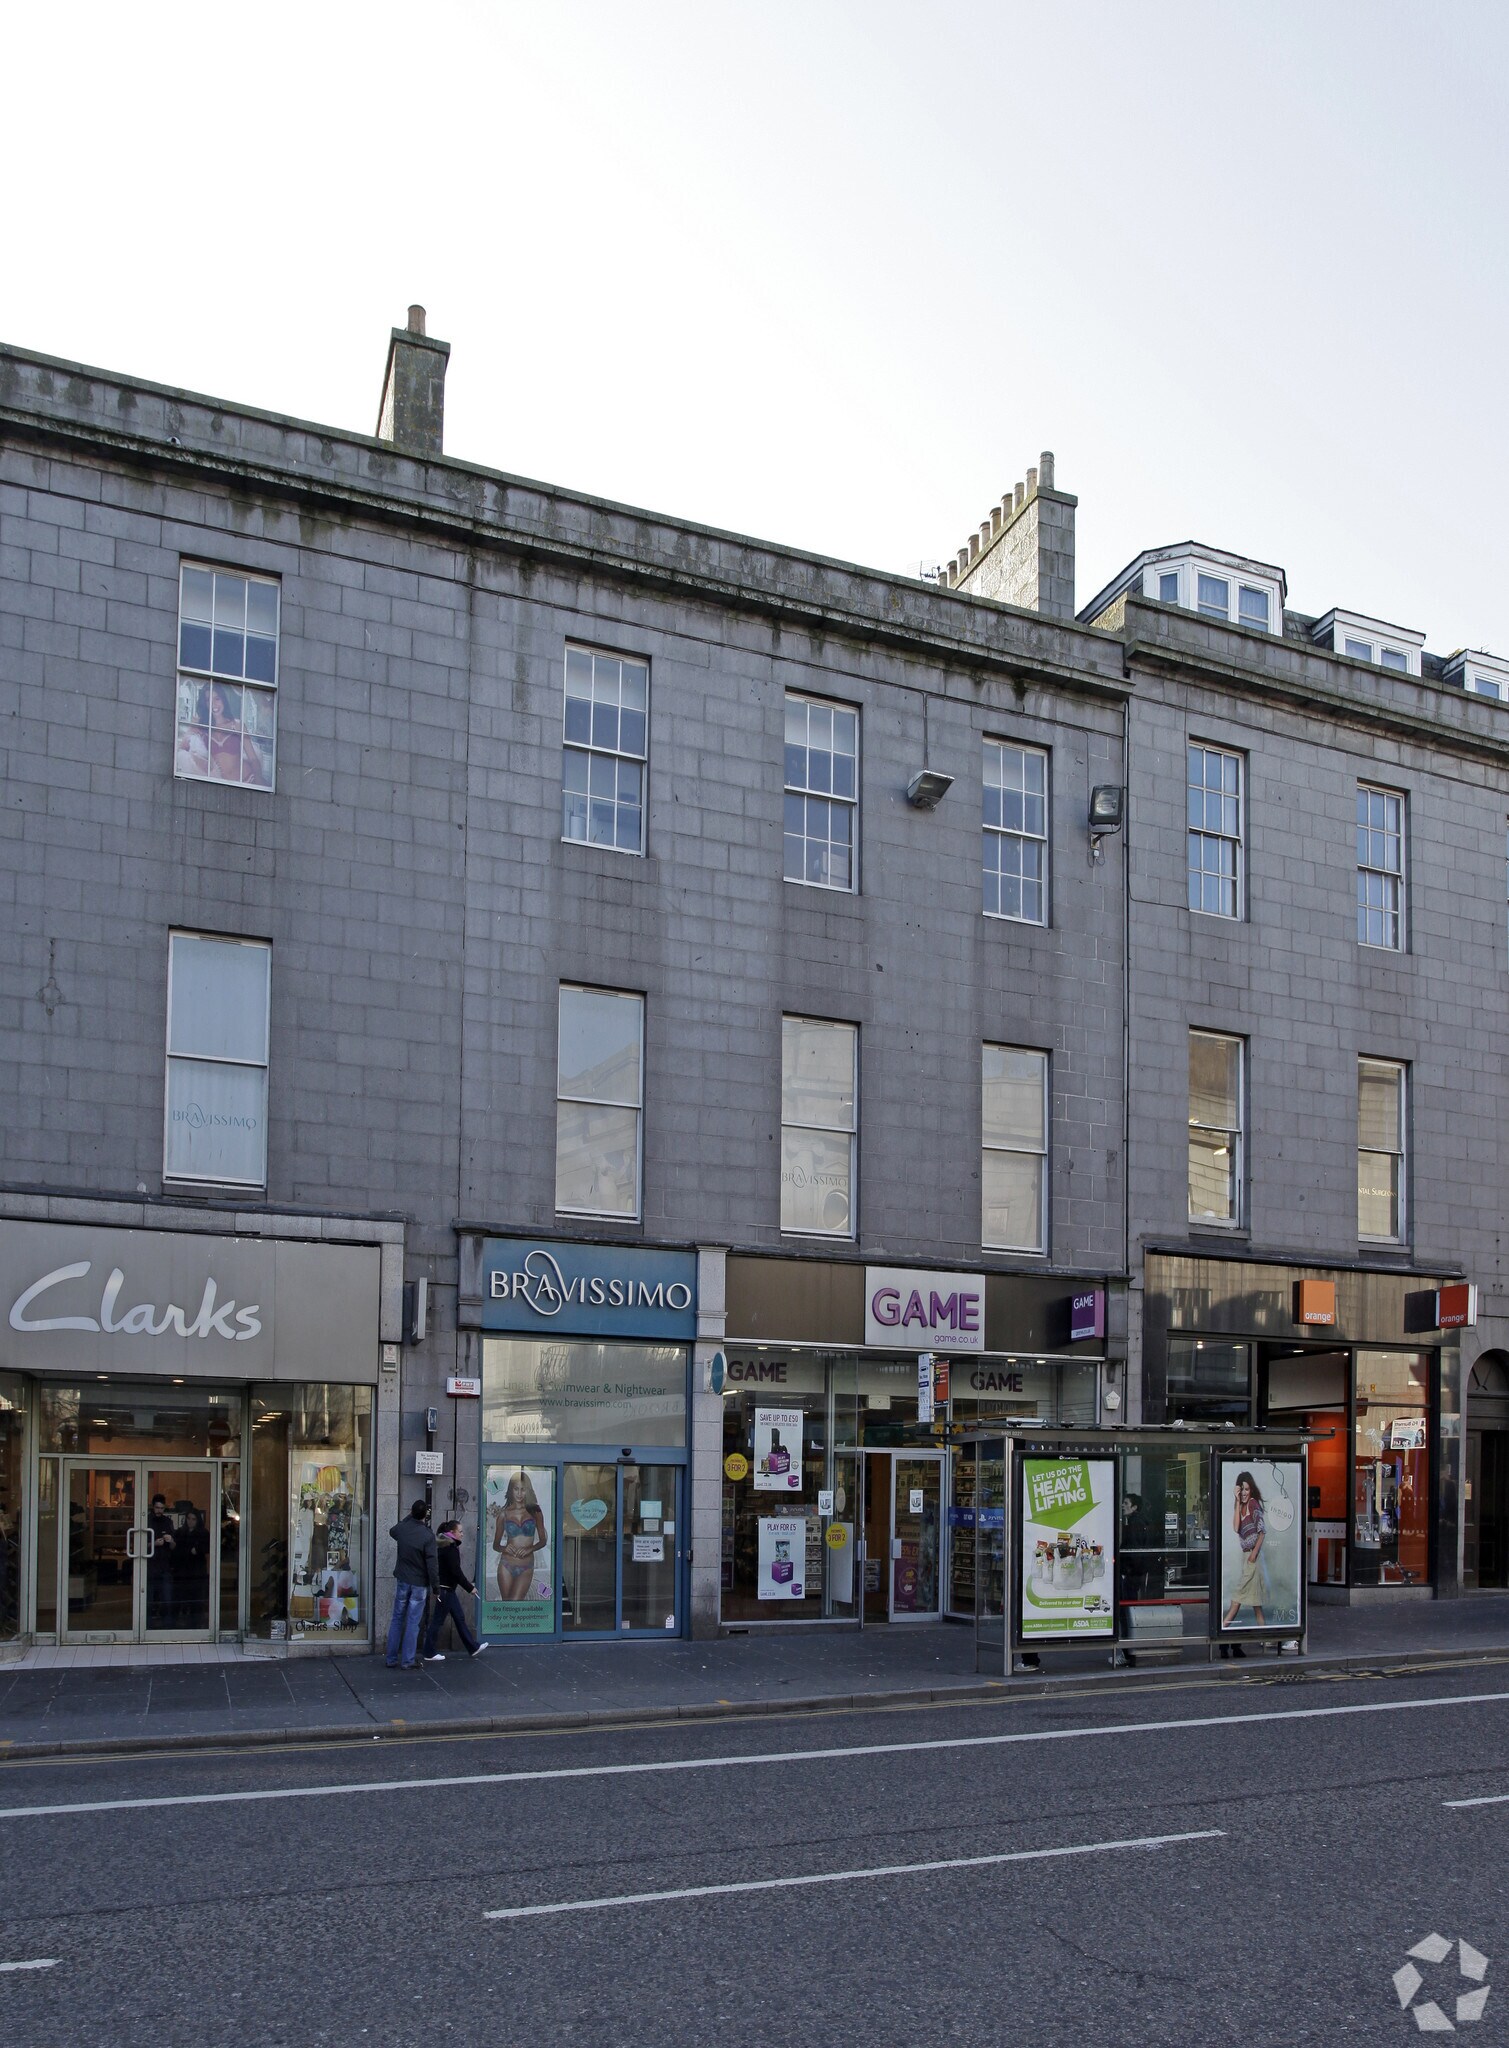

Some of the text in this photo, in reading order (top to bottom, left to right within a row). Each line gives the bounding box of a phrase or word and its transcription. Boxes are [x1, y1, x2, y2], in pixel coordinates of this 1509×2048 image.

[172, 1102, 257, 1130] BRAVISSIMO
[781, 1165, 847, 1188] BRAVISSIMO
[490, 1250, 692, 1316] BRAVISSIMO
[9, 1260, 262, 1341] Clarks
[1073, 1295, 1093, 1310] GAME
[871, 1287, 980, 1331] GAME
[1304, 1312, 1331, 1322] orange
[1440, 1314, 1464, 1324] orange
[934, 1334, 979, 1345] game.co.uk
[727, 1360, 787, 1383] GAME
[548, 1380, 600, 1393] Swimwear
[603, 1383, 612, 1394] &
[616, 1383, 667, 1397] Nightwear
[970, 1371, 1023, 1393] GAME
[539, 1397, 632, 1409] www.bravissimo.com
[760, 1413, 798, 1423] SAVE UP TO £50
[731, 1463, 742, 1472] FOR
[742, 1464, 746, 1472] 2
[1032, 1465, 1082, 1482] LET US DO THE
[1033, 1472, 1082, 1498] HEAVY
[1035, 1488, 1087, 1512] LIFTING
[1270, 1505, 1292, 1519] INDIGO
[767, 1523, 779, 1531] PLAY
[780, 1523, 789, 1531] FOR
[295, 1620, 357, 1633] Clarks Shop
[1073, 1620, 1089, 1628] ASDA
